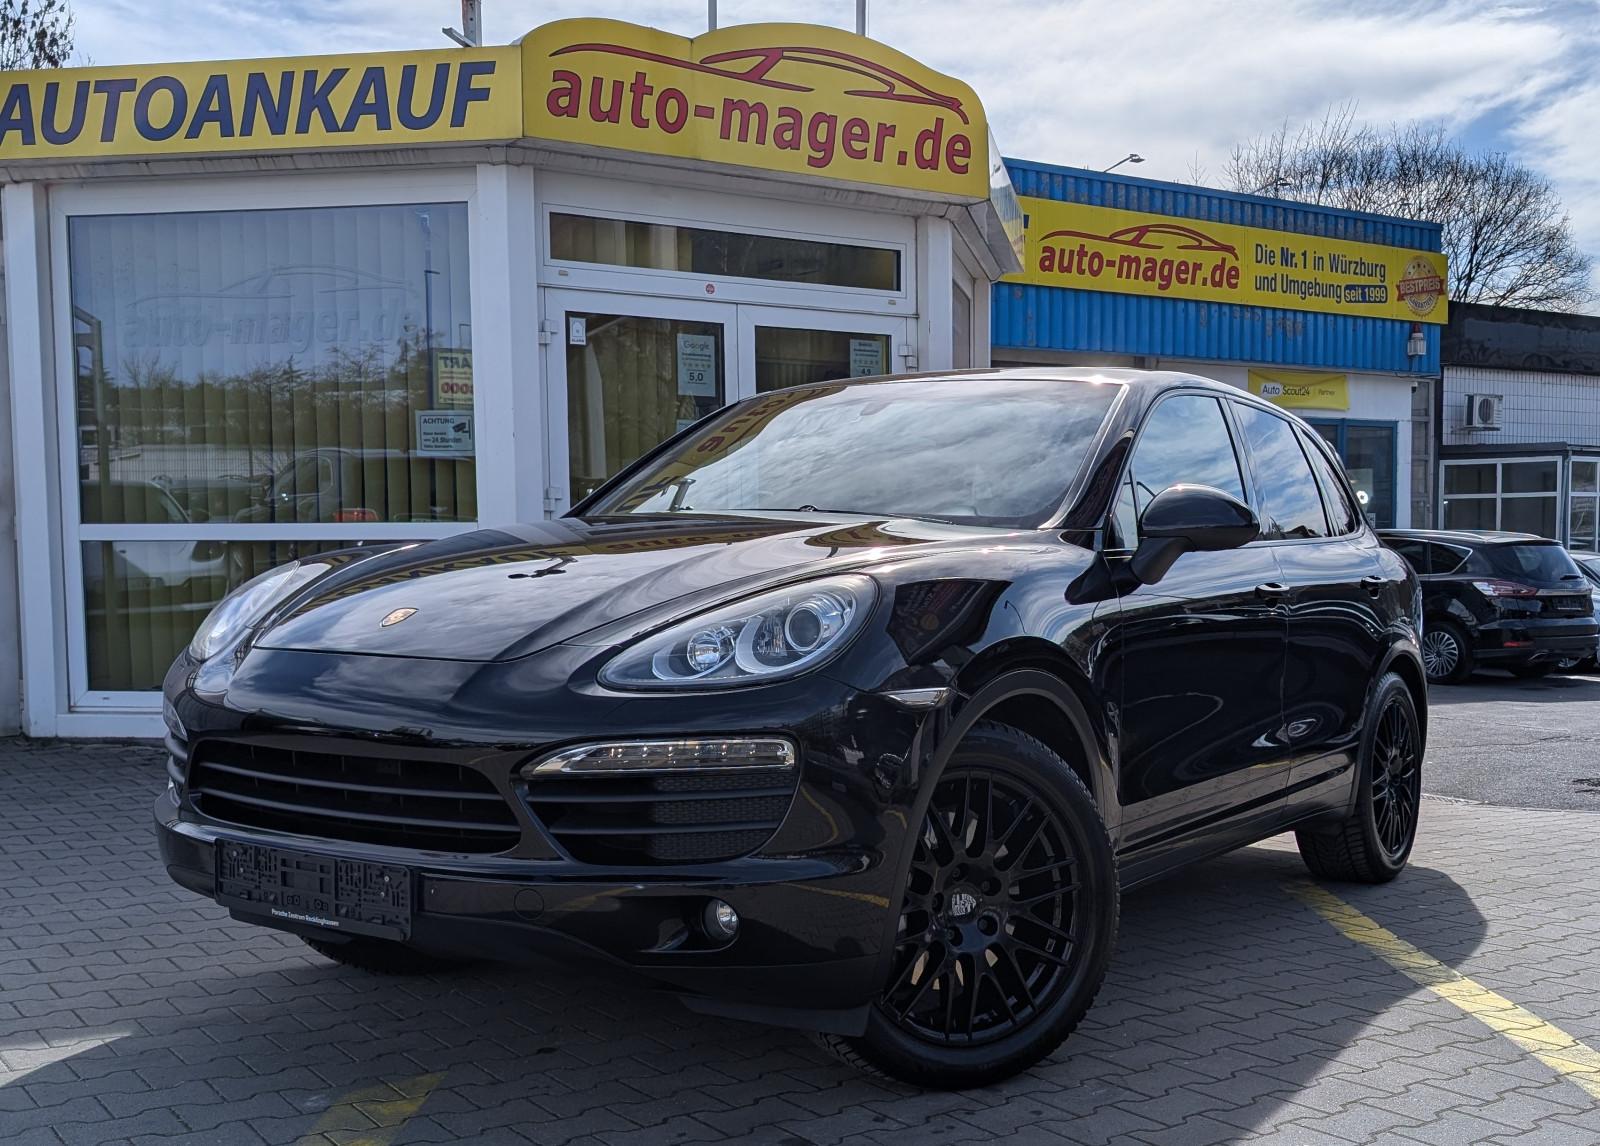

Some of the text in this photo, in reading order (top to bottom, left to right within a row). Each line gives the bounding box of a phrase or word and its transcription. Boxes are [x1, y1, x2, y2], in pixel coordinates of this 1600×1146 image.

[0, 61, 496, 147] AUTOANKAUF
[546, 70, 972, 175] auto-mager.de
[1039, 243, 1240, 290] auto-mager.de
[1255, 243, 1386, 283] Die Nr. 1 in Würzburg
[1254, 272, 1386, 303] und Umgebung seit 1999
[1400, 278, 1440, 294] BESTPREIS
[683, 340, 710, 351] Google
[689, 372, 704, 382] 5,0
[423, 417, 455, 425] ACHTUNG
